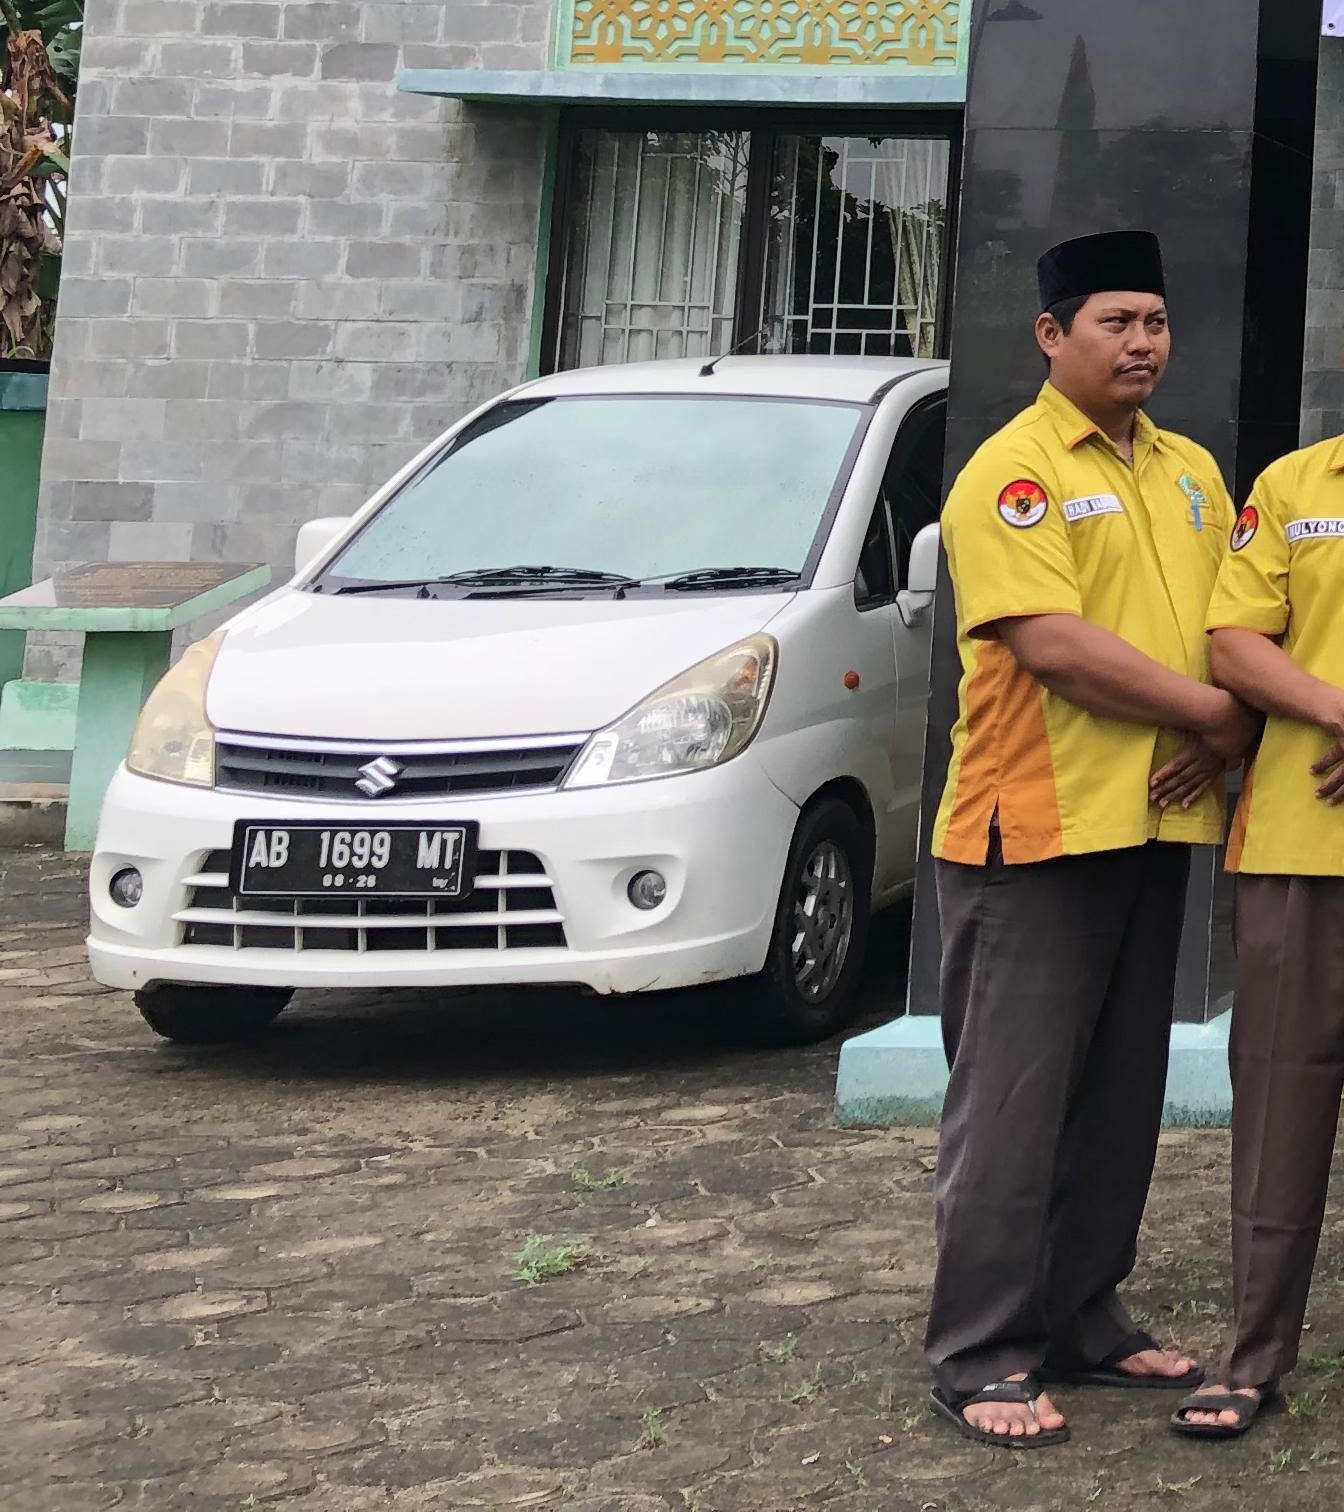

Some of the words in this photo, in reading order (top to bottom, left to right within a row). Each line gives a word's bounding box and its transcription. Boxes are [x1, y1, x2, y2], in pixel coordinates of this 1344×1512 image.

[249, 830, 291, 868] AB
[319, 831, 392, 869] 1699
[416, 831, 460, 870] MT
